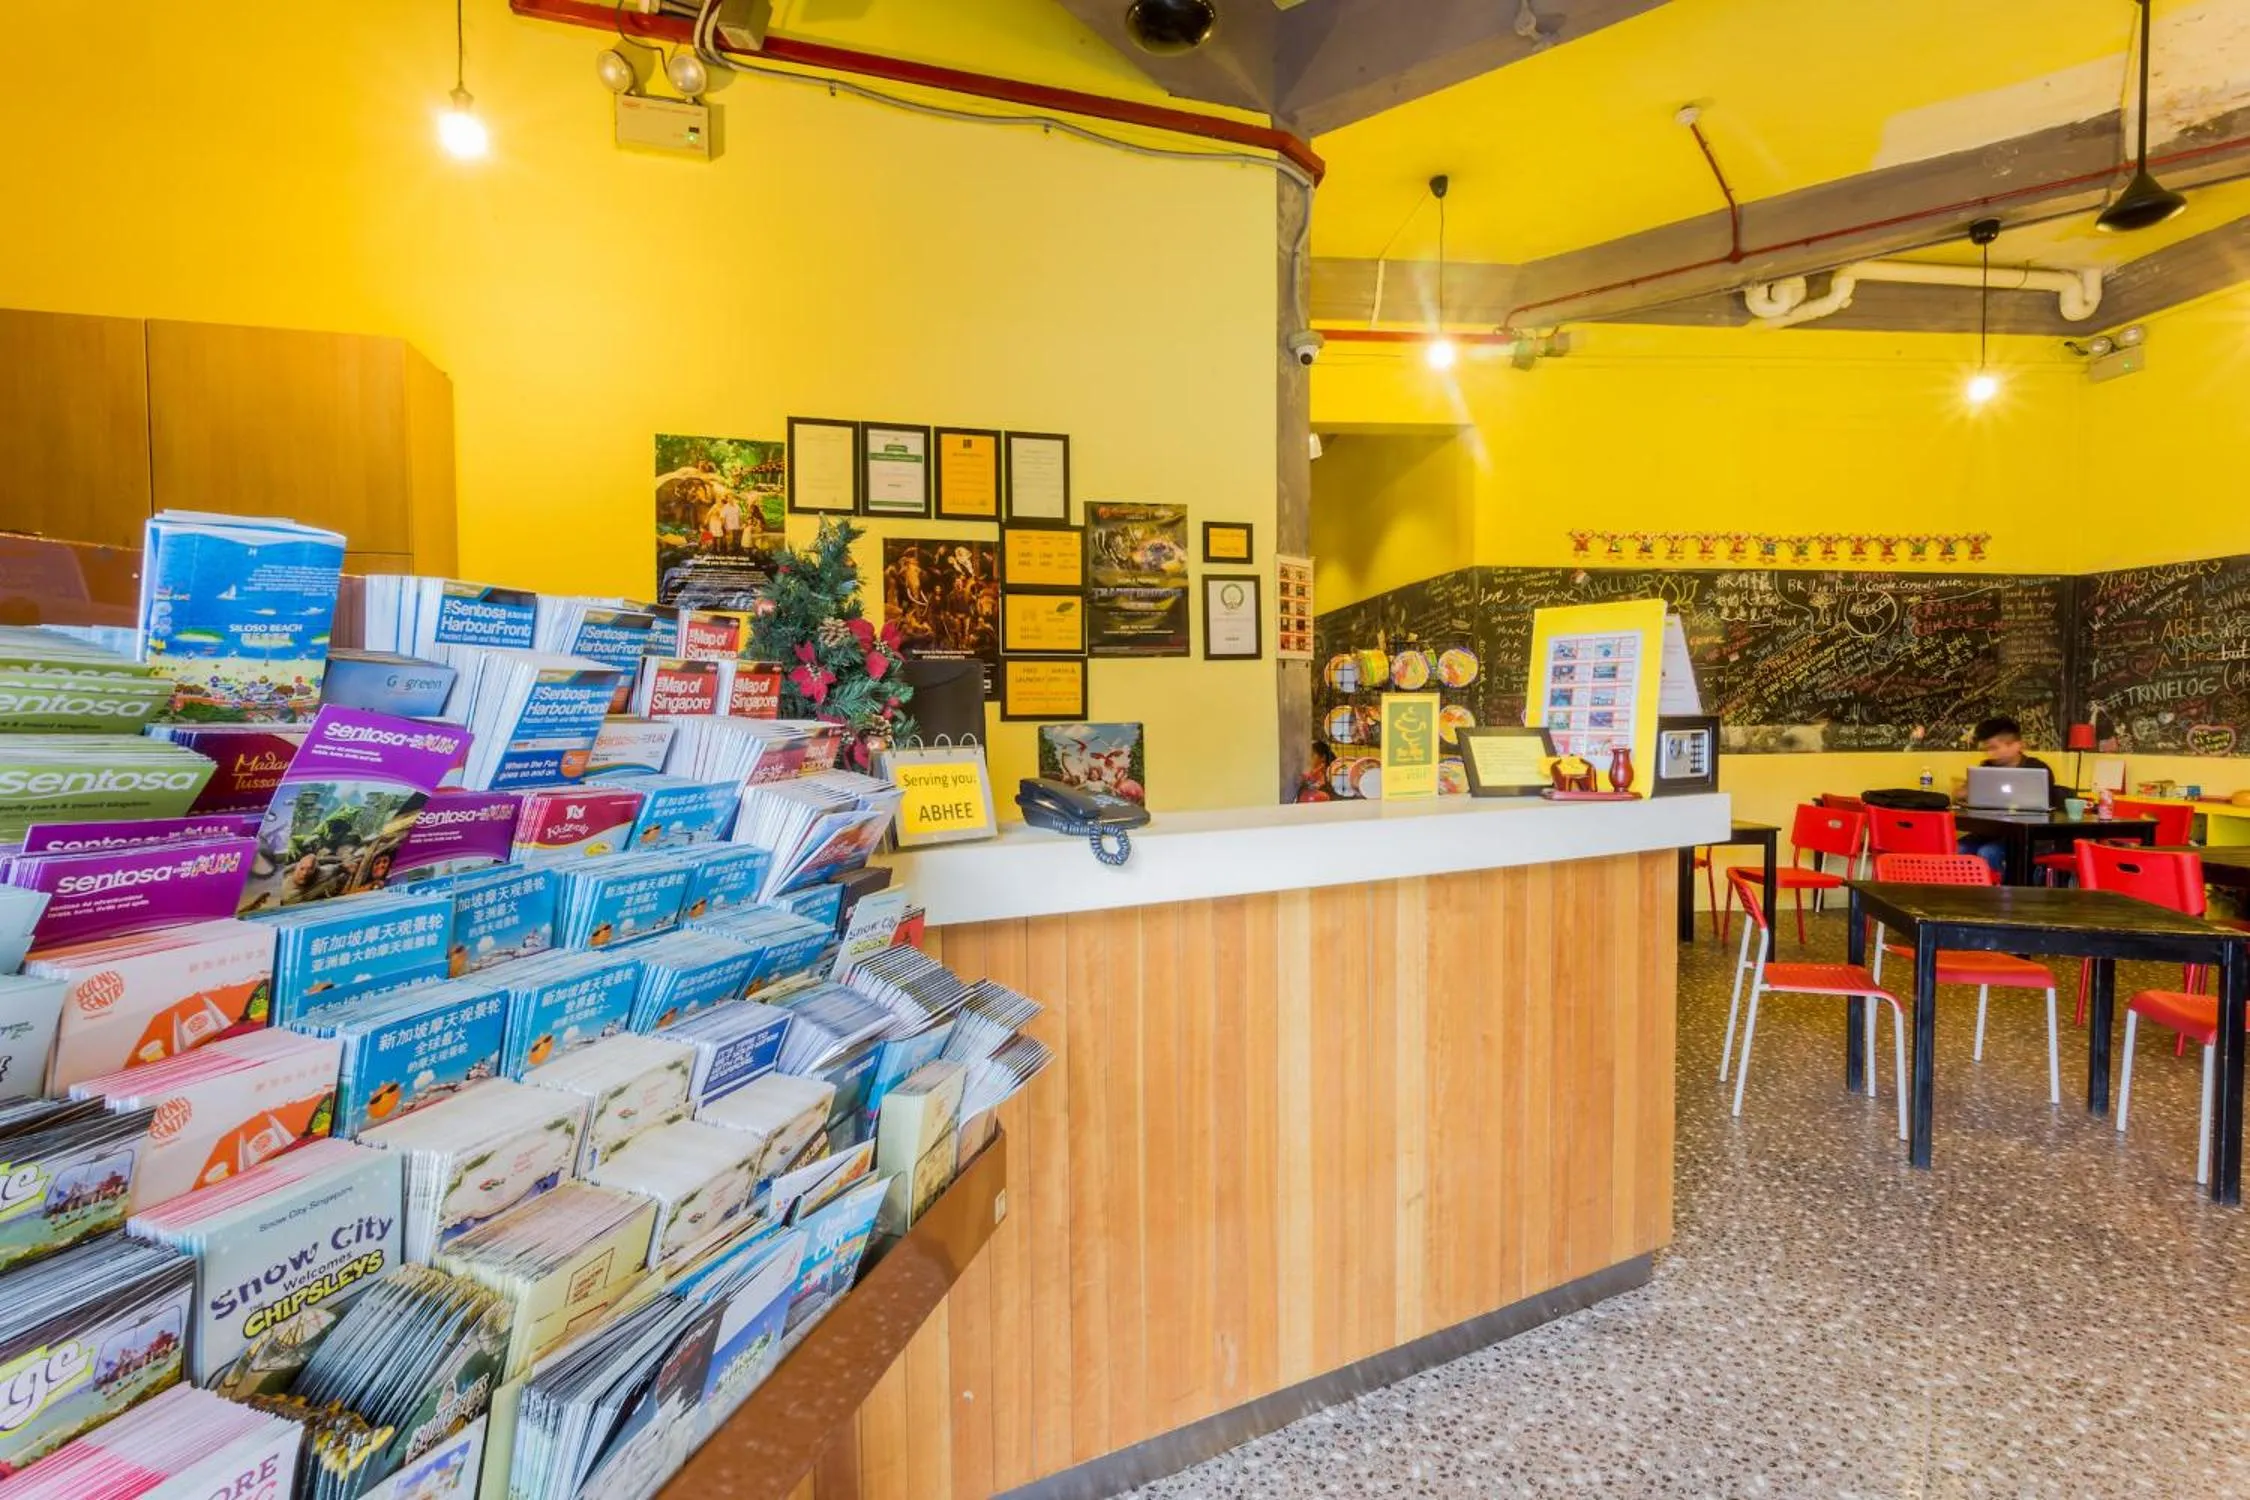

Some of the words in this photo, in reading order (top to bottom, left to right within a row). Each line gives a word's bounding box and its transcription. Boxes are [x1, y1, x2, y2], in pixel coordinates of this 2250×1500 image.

[440, 616, 532, 638] HarbourFront
[664, 677, 686, 695] Map
[688, 677, 702, 692] of
[741, 678, 757, 694] Map
[757, 678, 769, 692] of
[652, 693, 711, 713] Singapore
[731, 692, 778, 710] Singapore
[323, 721, 406, 746] sentosa
[232, 752, 289, 772] Mada
[0, 768, 200, 796] sentosa
[903, 773, 949, 788] Serving
[415, 807, 475, 828] sentosa
[919, 802, 975, 823] ABHEE
[56, 864, 171, 896] sentosa
[454, 876, 545, 914] 加坡摩天观景轮
[309, 912, 445, 956] 新加坡摩天观景轮
[377, 997, 502, 1053] 新加坡摩天观景轮
[330, 1215, 394, 1251] City
[282, 1250, 353, 1292] Welcomes
[242, 1248, 385, 1339] CHIPSLEYS
